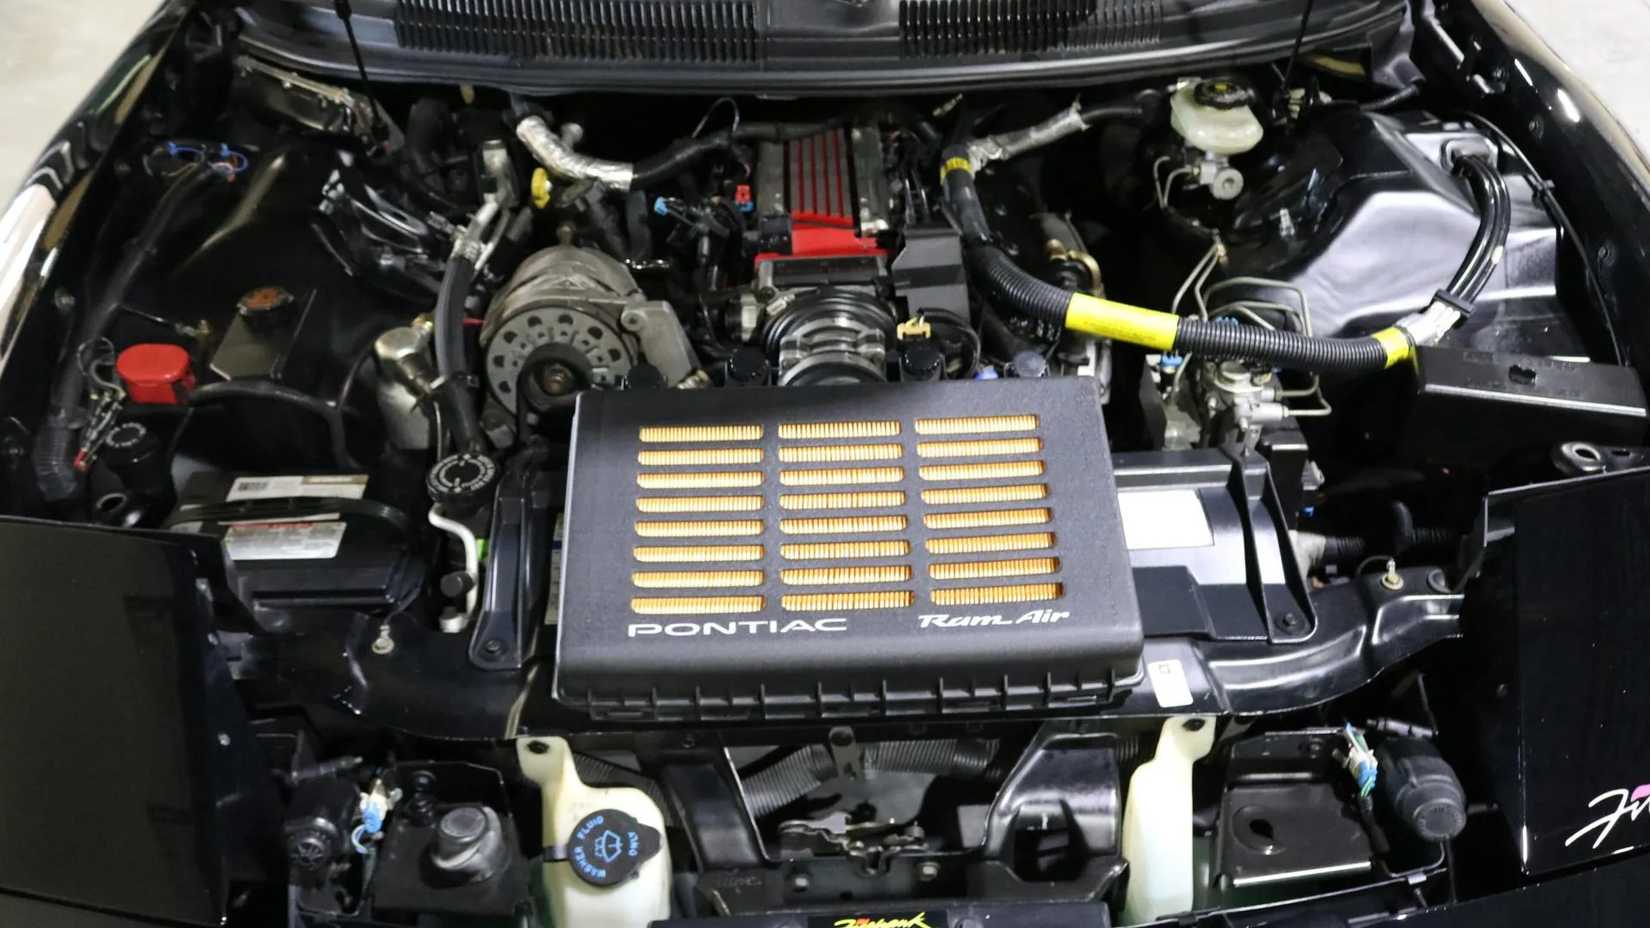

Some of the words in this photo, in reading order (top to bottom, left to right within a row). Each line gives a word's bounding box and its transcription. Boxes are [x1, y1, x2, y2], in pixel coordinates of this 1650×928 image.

[627, 618, 848, 638] PONTIAC
[918, 614, 1013, 628] Ram
[1015, 609, 1071, 624] Air
[576, 815, 605, 840] FLUID
[627, 831, 641, 857] ONLY
[574, 846, 607, 879] WASHER
